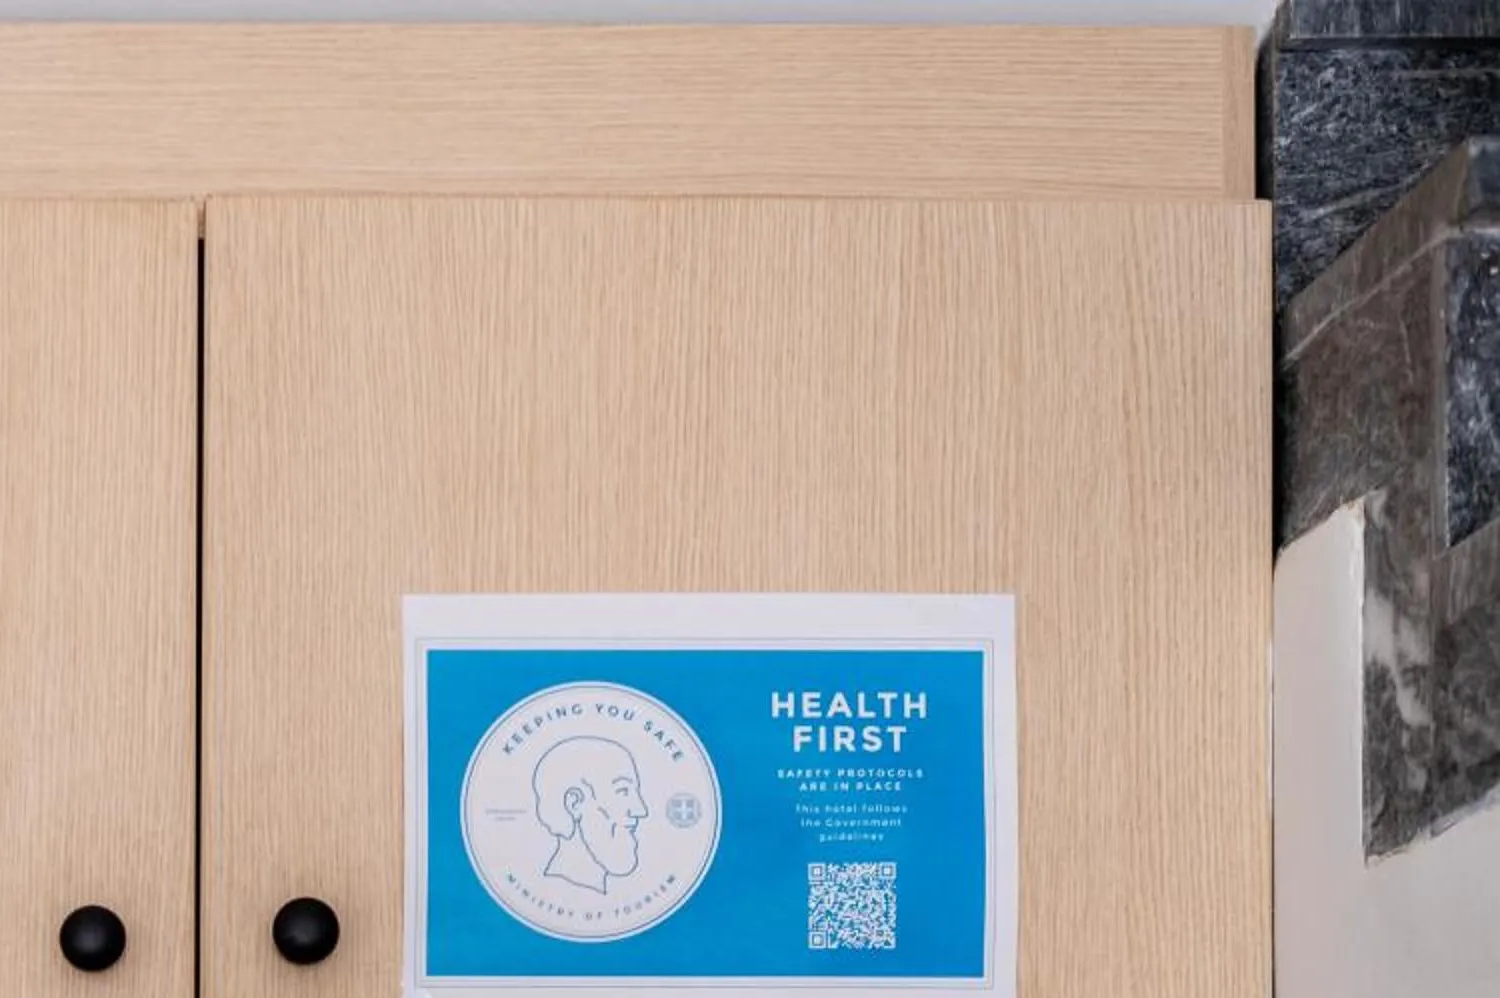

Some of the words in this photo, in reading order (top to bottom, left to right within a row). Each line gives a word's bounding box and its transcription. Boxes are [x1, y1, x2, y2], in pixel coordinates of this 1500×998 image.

[771, 691, 927, 719] HEALTH
[502, 703, 583, 755] KEEPING
[595, 703, 636, 721] YOU
[643, 720, 685, 762] SAFE
[793, 725, 907, 753] FIRST
[777, 768, 830, 779] SAFETY
[837, 768, 924, 779] PROTOCOLS
[799, 782, 827, 792] ARE
[833, 782, 849, 791] IN
[855, 781, 901, 791] PLACE
[825, 803, 857, 814] hotel
[862, 803, 908, 814] follows
[583, 910, 604, 921] OF
